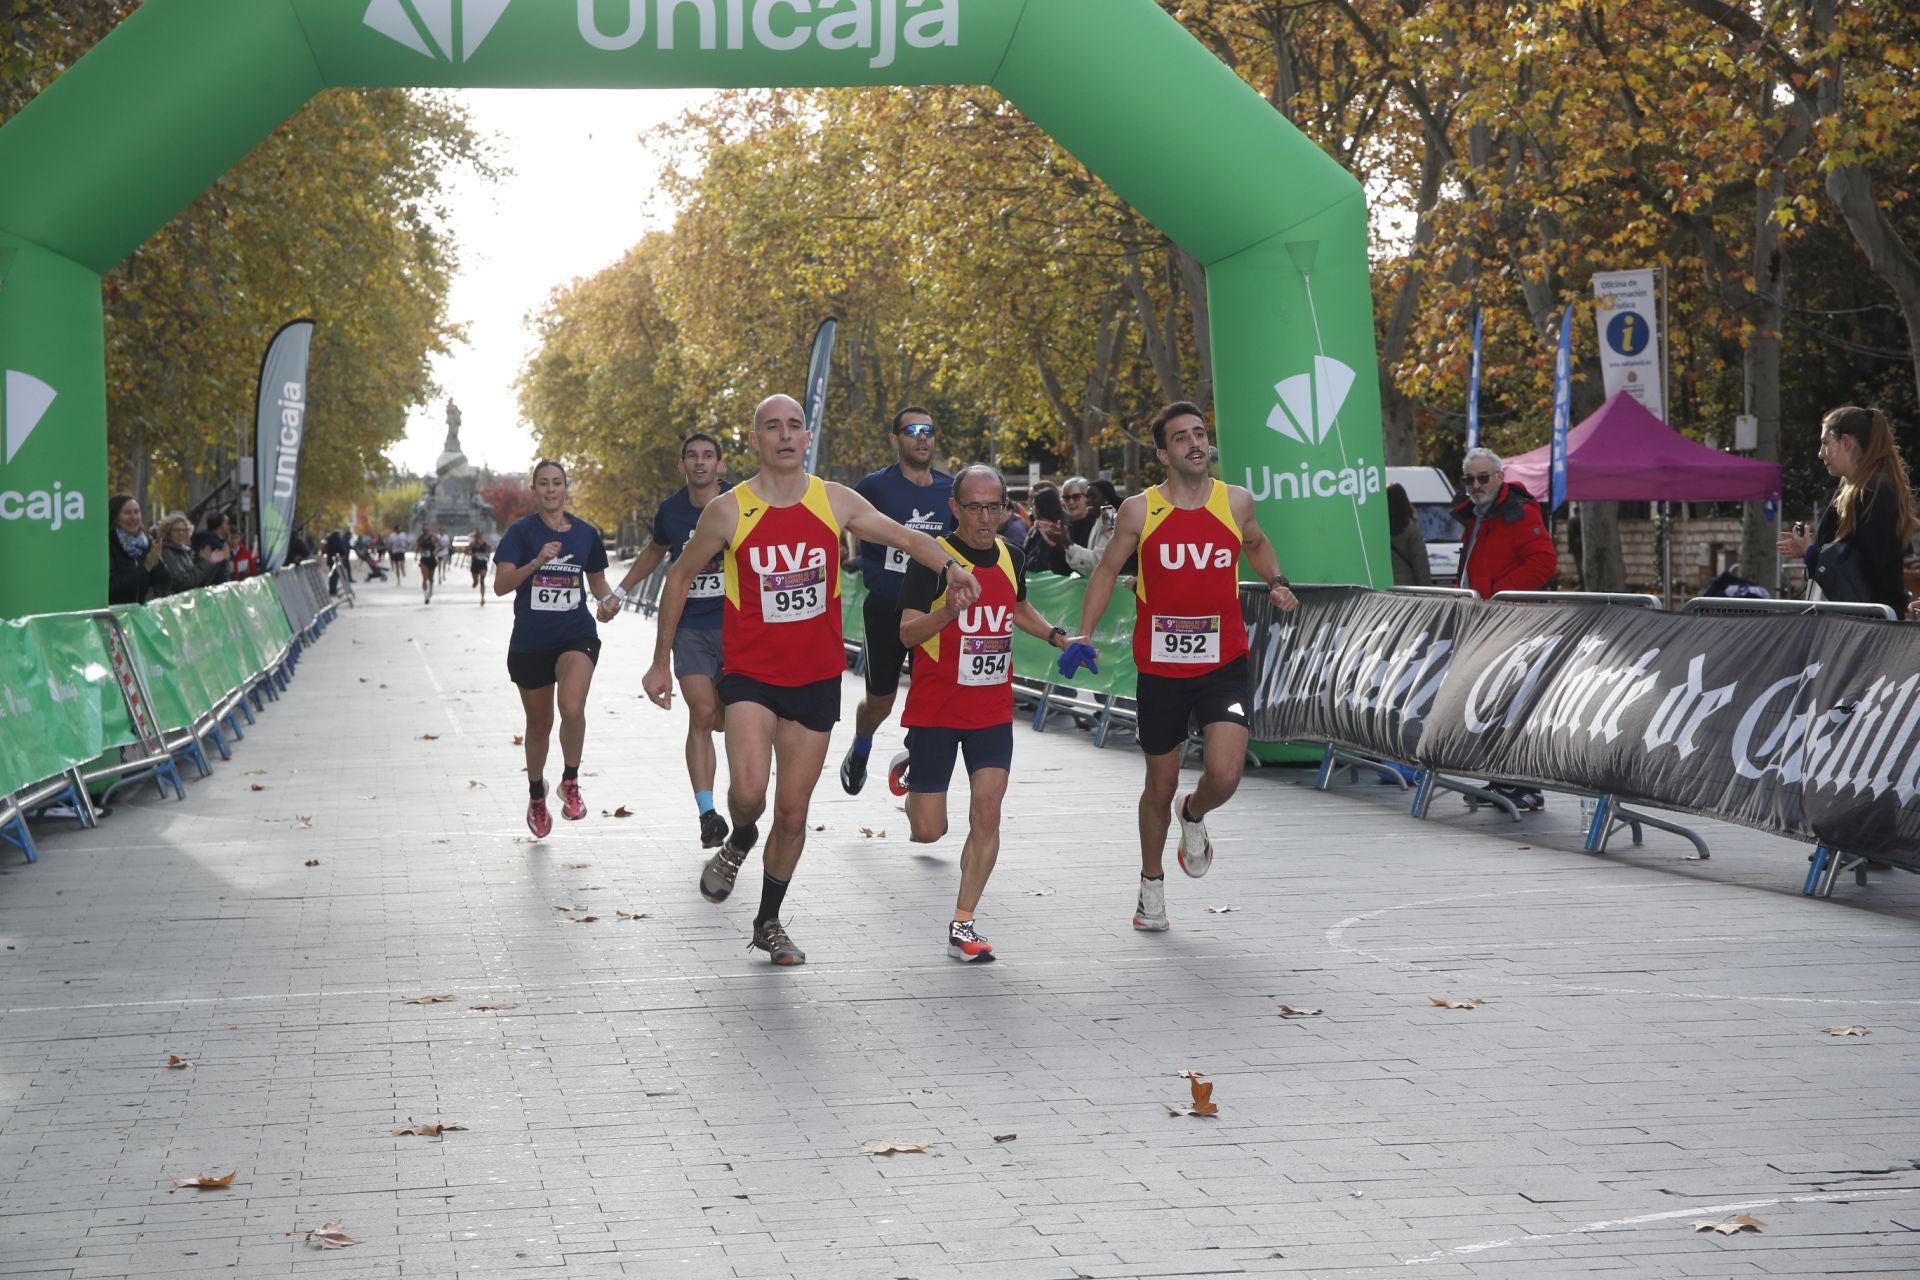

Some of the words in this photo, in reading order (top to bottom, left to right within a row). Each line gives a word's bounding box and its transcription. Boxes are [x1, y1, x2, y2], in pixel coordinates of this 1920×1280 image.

[577, 0, 959, 68] Unicaja
[1245, 458, 1380, 505] Unicaja
[749, 542, 827, 576] UVa
[1160, 543, 1232, 570] UVa
[538, 588, 571, 604] 671
[775, 586, 818, 612] 953
[958, 605, 1013, 634] UVa
[1165, 634, 1207, 654] 952
[971, 654, 1006, 676] 954
[1641, 652, 1739, 761] de
